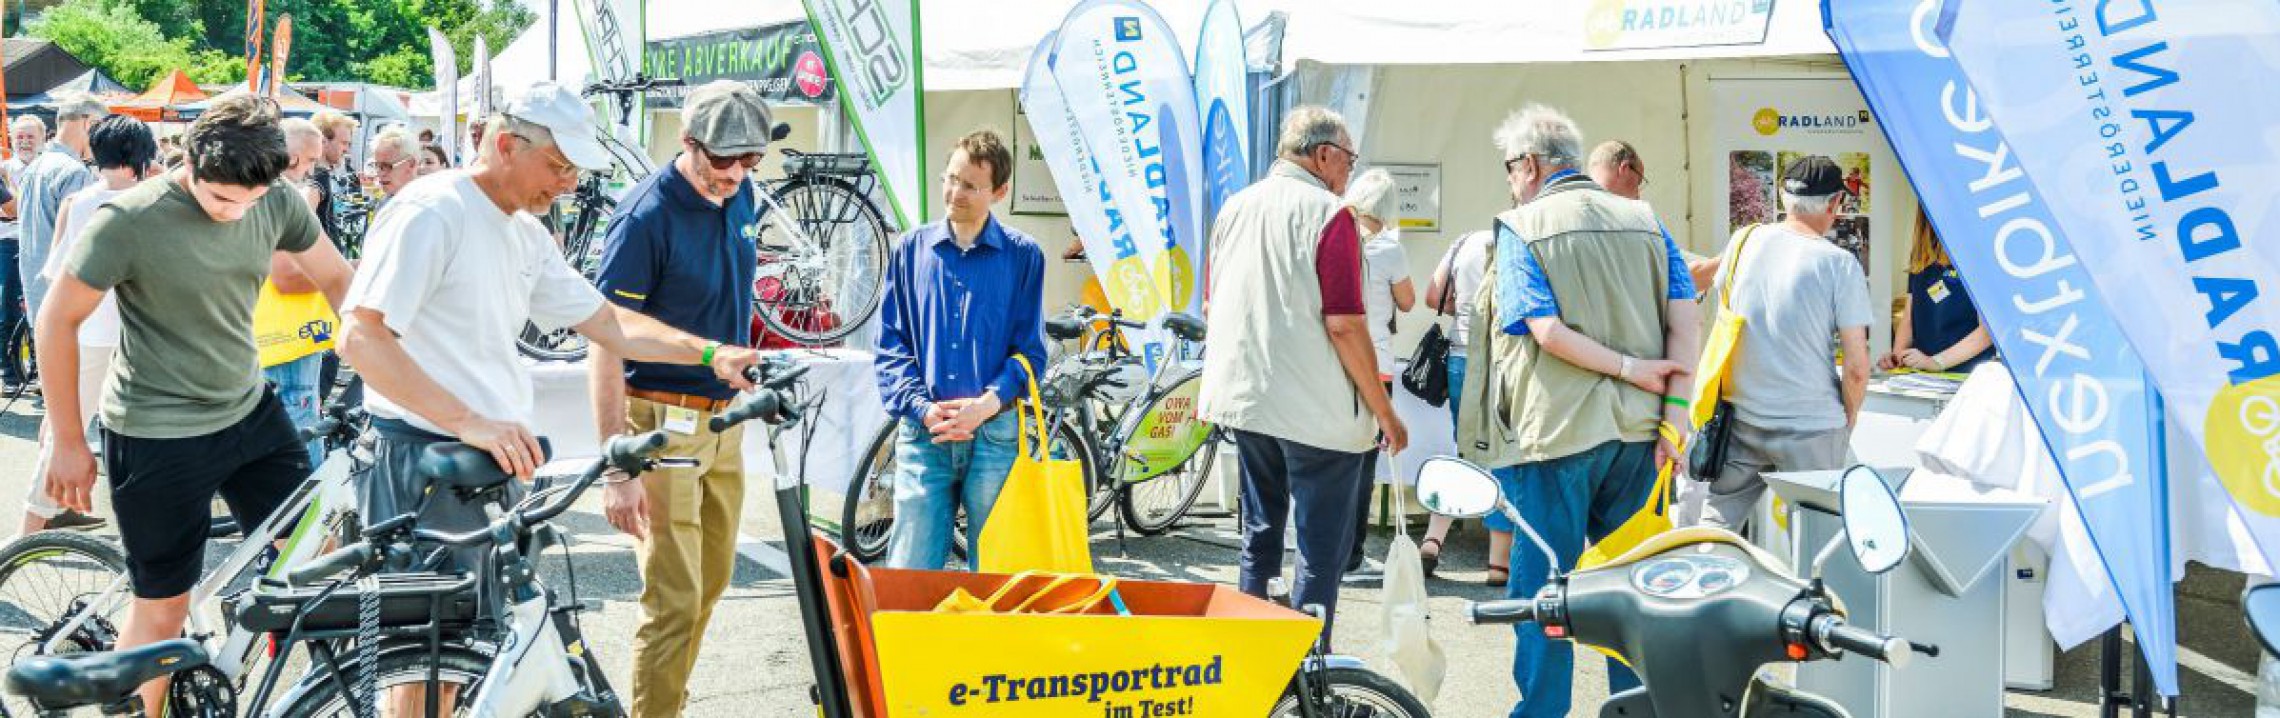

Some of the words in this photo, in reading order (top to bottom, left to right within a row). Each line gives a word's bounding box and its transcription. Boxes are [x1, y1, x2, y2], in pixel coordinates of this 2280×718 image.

[1621, 3, 1746, 31] RADLAND
[684, 34, 793, 77] ABVERKAUF
[1778, 115, 1856, 127] RADLAND
[948, 654, 1222, 706] e-Transportrad
[1104, 700, 1133, 718] im
[1138, 696, 1194, 718] Test!
